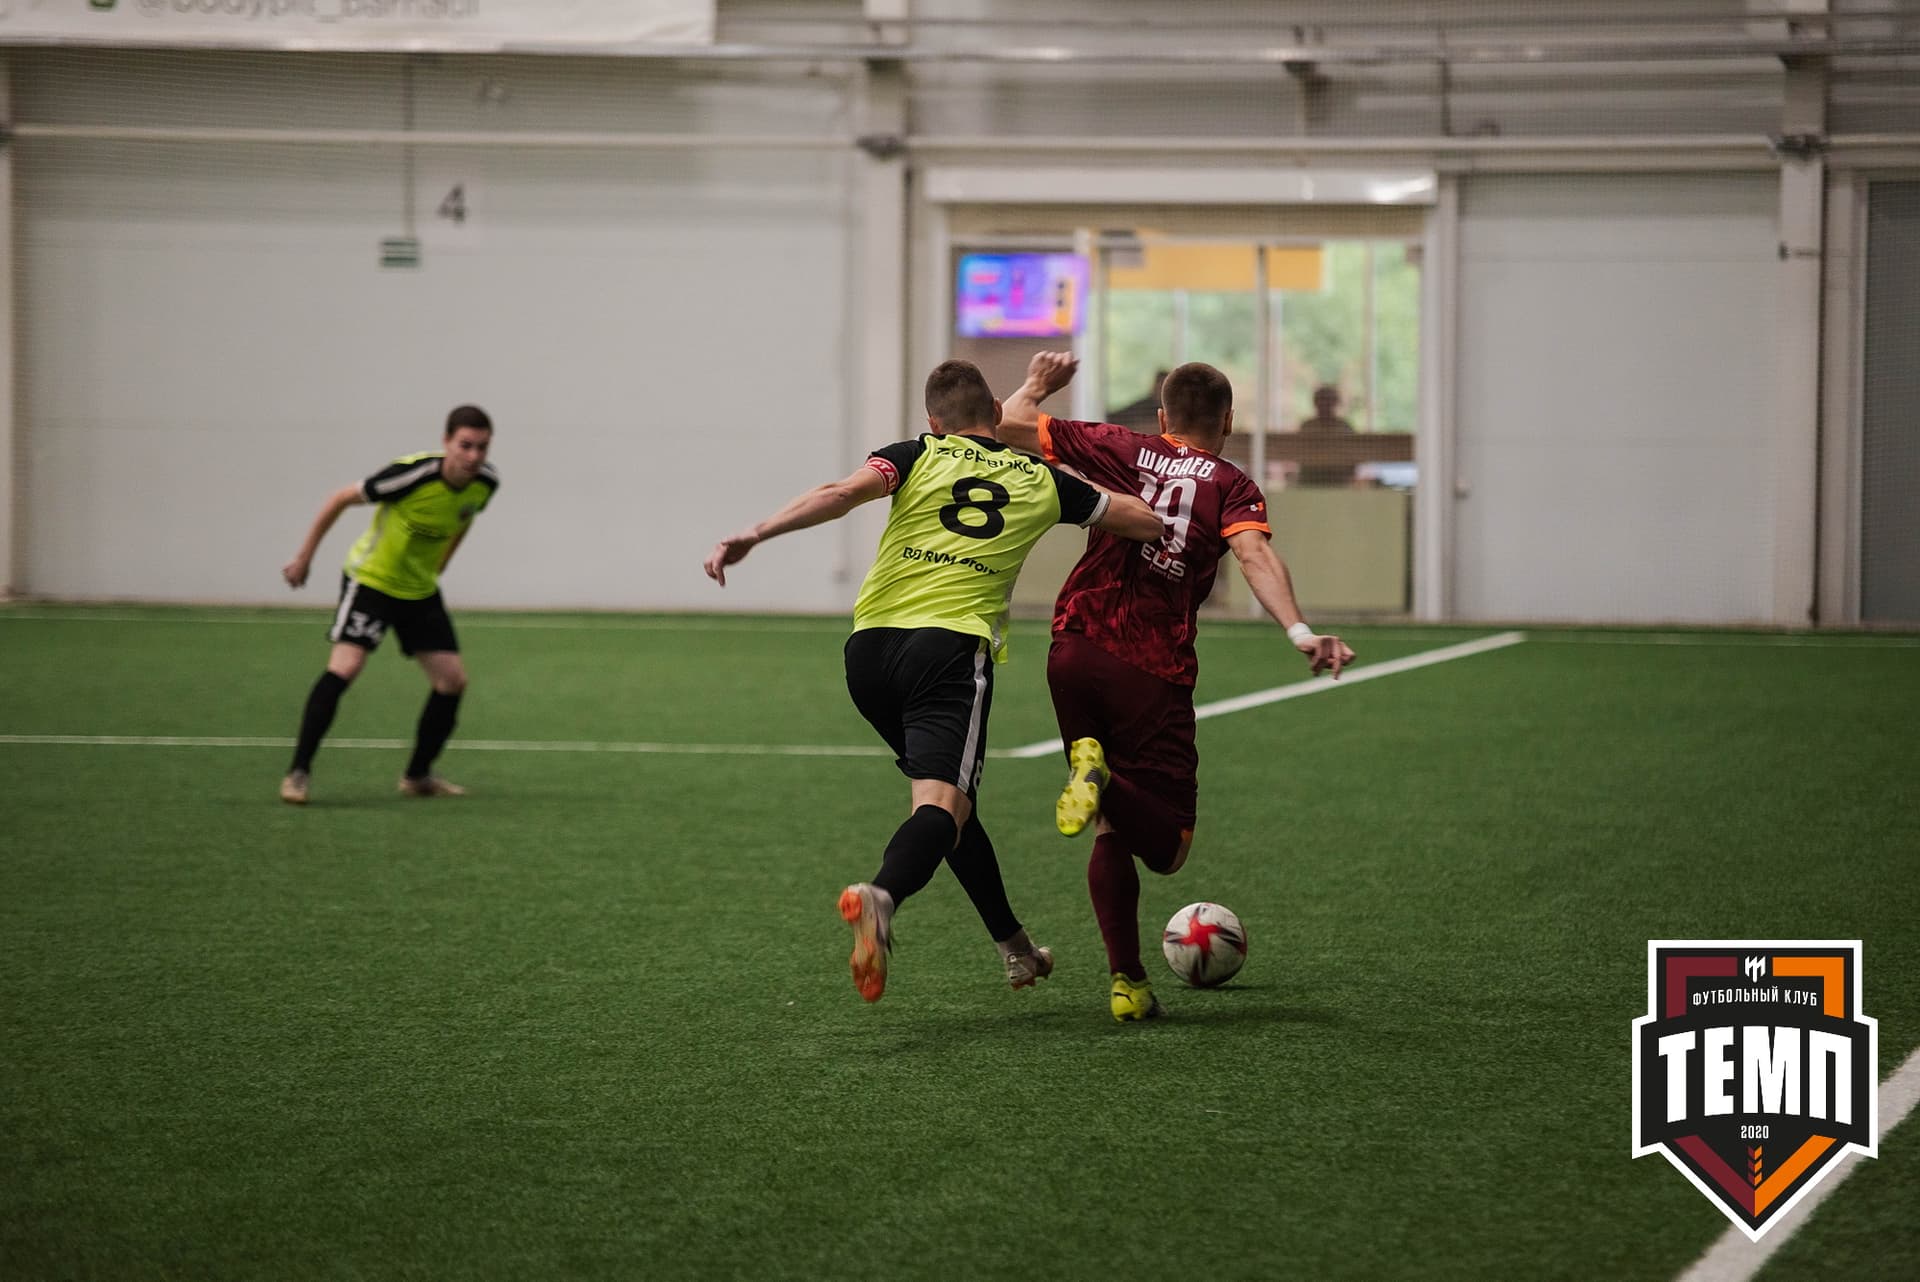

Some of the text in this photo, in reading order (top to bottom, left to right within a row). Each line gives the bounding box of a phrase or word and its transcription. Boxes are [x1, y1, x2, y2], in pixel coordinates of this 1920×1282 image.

[1136, 447, 1216, 479] ШИБАЕВ
[939, 476, 1010, 539] 8
[923, 550, 957, 565] RVM
[1141, 542, 1186, 577] EUS
[345, 610, 384, 643] 34
